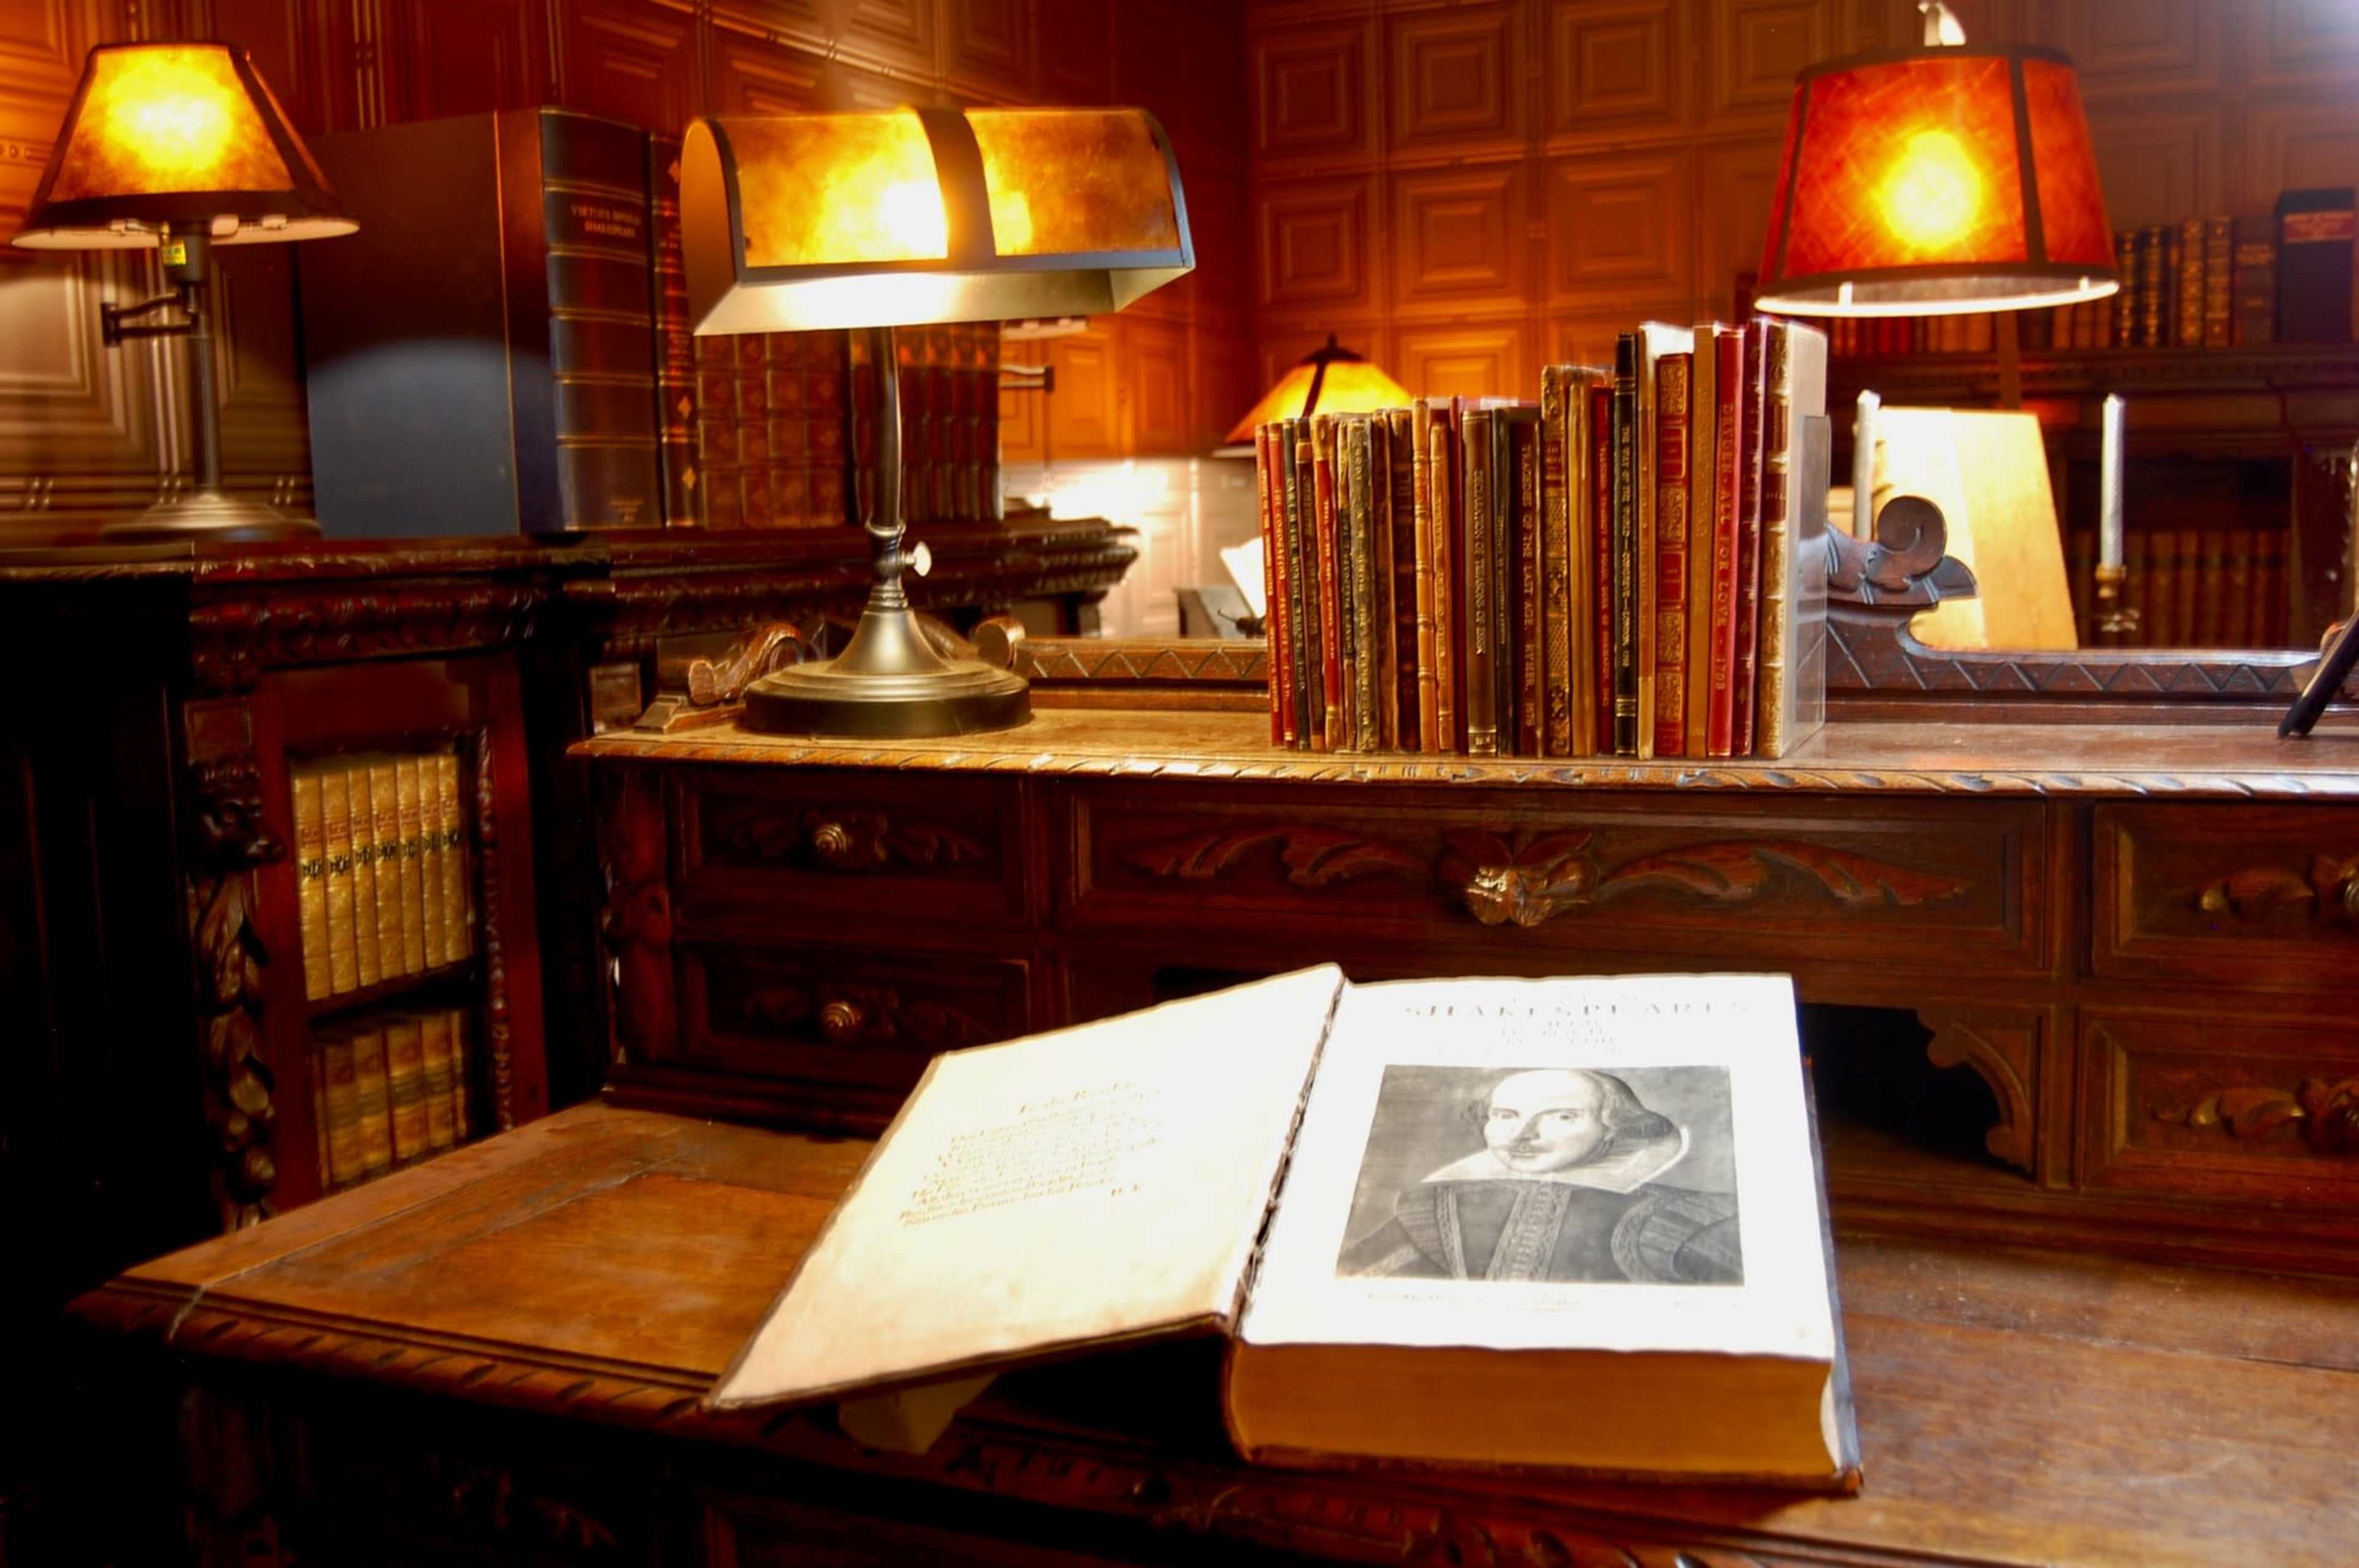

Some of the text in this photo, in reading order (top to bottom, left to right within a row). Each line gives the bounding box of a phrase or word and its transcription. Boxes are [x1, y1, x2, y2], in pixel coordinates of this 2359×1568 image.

[1621, 426, 1630, 443] THE
[1721, 403, 1733, 473] DRYDEN
[1621, 448, 1630, 467] WAY
[1621, 470, 1630, 483] OF
[1621, 485, 1630, 502] THE
[1720, 490, 1732, 525] ALL
[1522, 514, 1531, 529] OF
[1474, 542, 1484, 555] OF
[1523, 534, 1532, 558] THE
[1718, 536, 1729, 571] FOR
[1524, 565, 1533, 595] LAST
[1716, 581, 1728, 627] LOVE
[1476, 610, 1485, 624] OF
